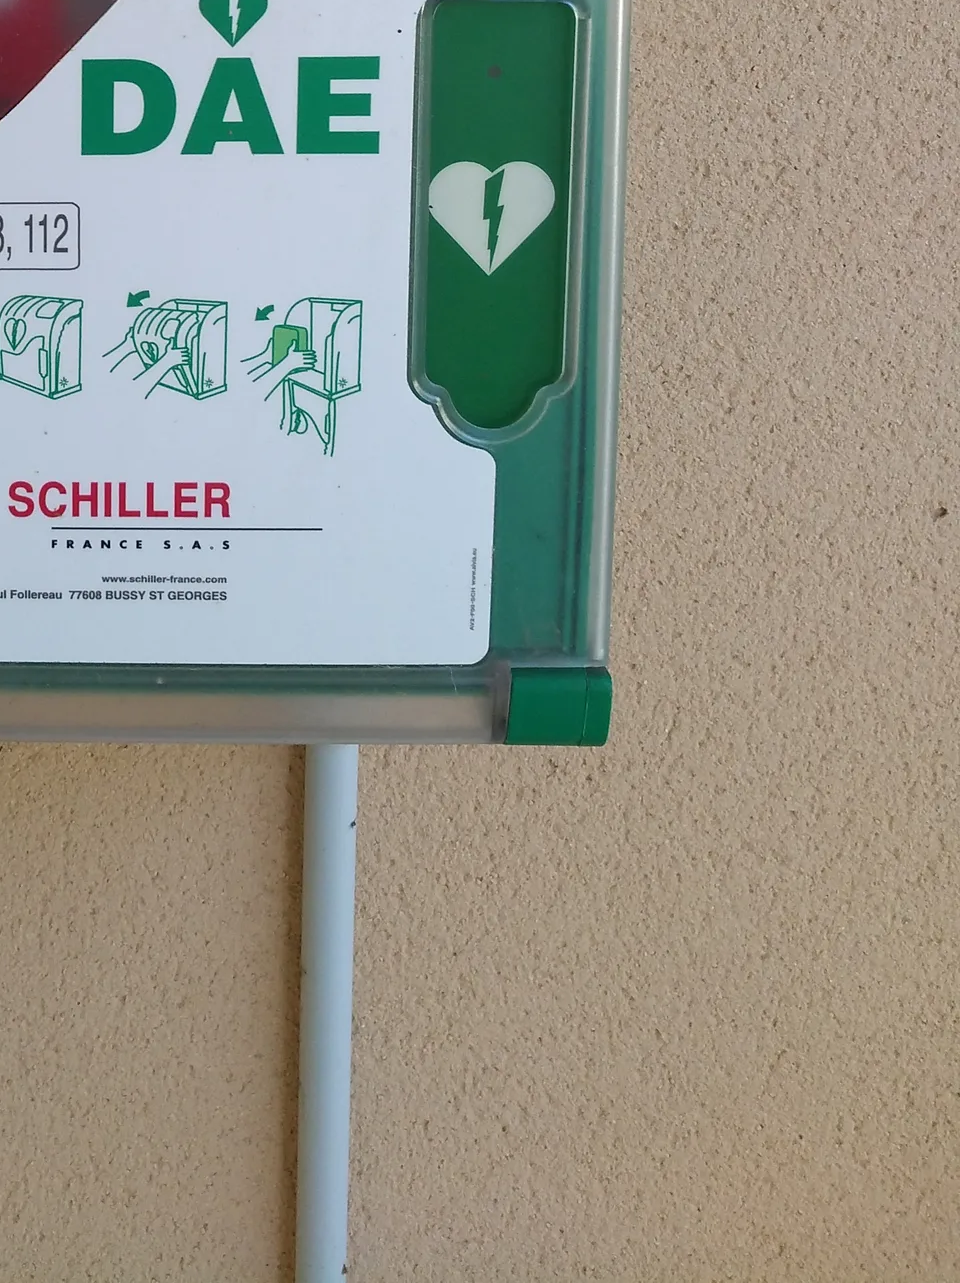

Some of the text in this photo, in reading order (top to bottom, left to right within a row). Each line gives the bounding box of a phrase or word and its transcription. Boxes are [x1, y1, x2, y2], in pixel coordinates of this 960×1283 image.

[81, 56, 381, 156] DAE
[24, 213, 69, 254] 112
[8, 480, 232, 519] SCHILLER
[51, 539, 144, 550] FRANCE
[101, 575, 228, 585] www.schiller-france.com
[10, 590, 63, 600] Follereau
[68, 590, 103, 601] 77608
[105, 590, 146, 601] BUSSY
[148, 591, 166, 601] ST
[167, 591, 228, 602] GEORGES
